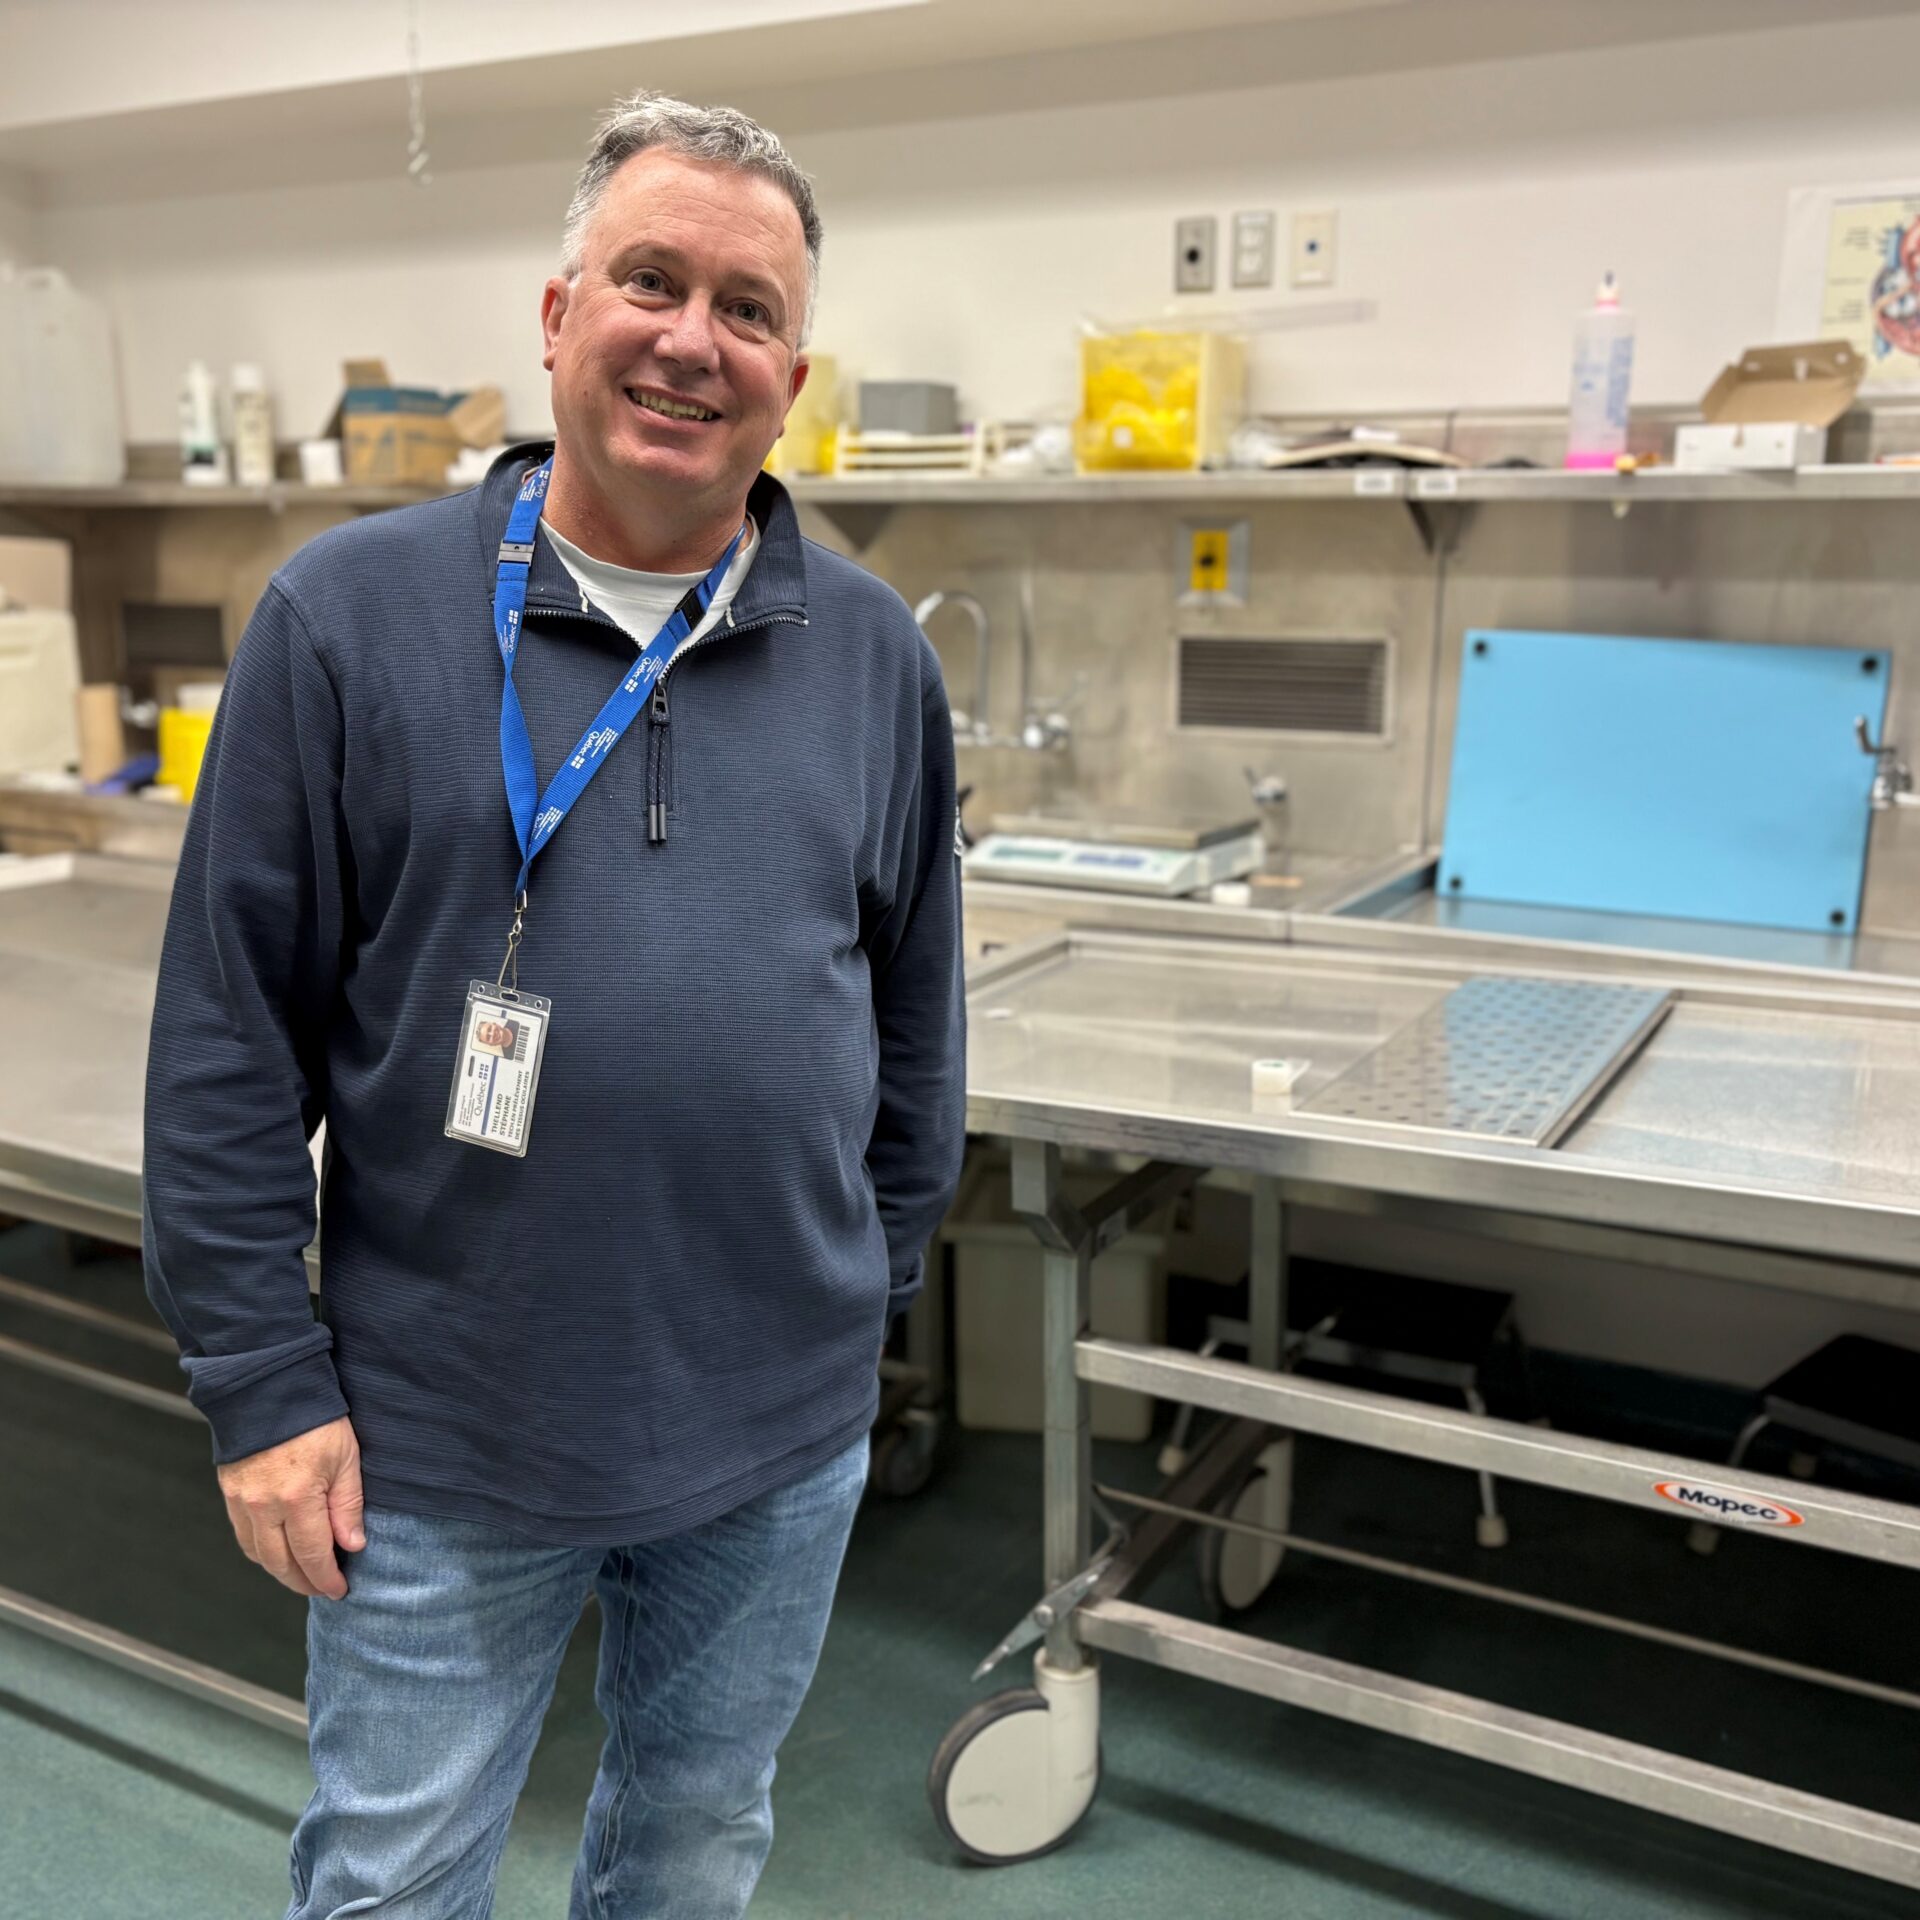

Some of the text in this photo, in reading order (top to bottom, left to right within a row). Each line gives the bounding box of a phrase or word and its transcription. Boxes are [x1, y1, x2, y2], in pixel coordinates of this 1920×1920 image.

[474, 1081, 487, 1116] Québec
[520, 1071, 530, 1105] OCULAIRES
[491, 1093, 503, 1132] THELLEND
[499, 1095, 511, 1136] STÉPHANE
[516, 1105, 525, 1127] TISSUS
[1678, 1487, 1778, 1520] Mopec
